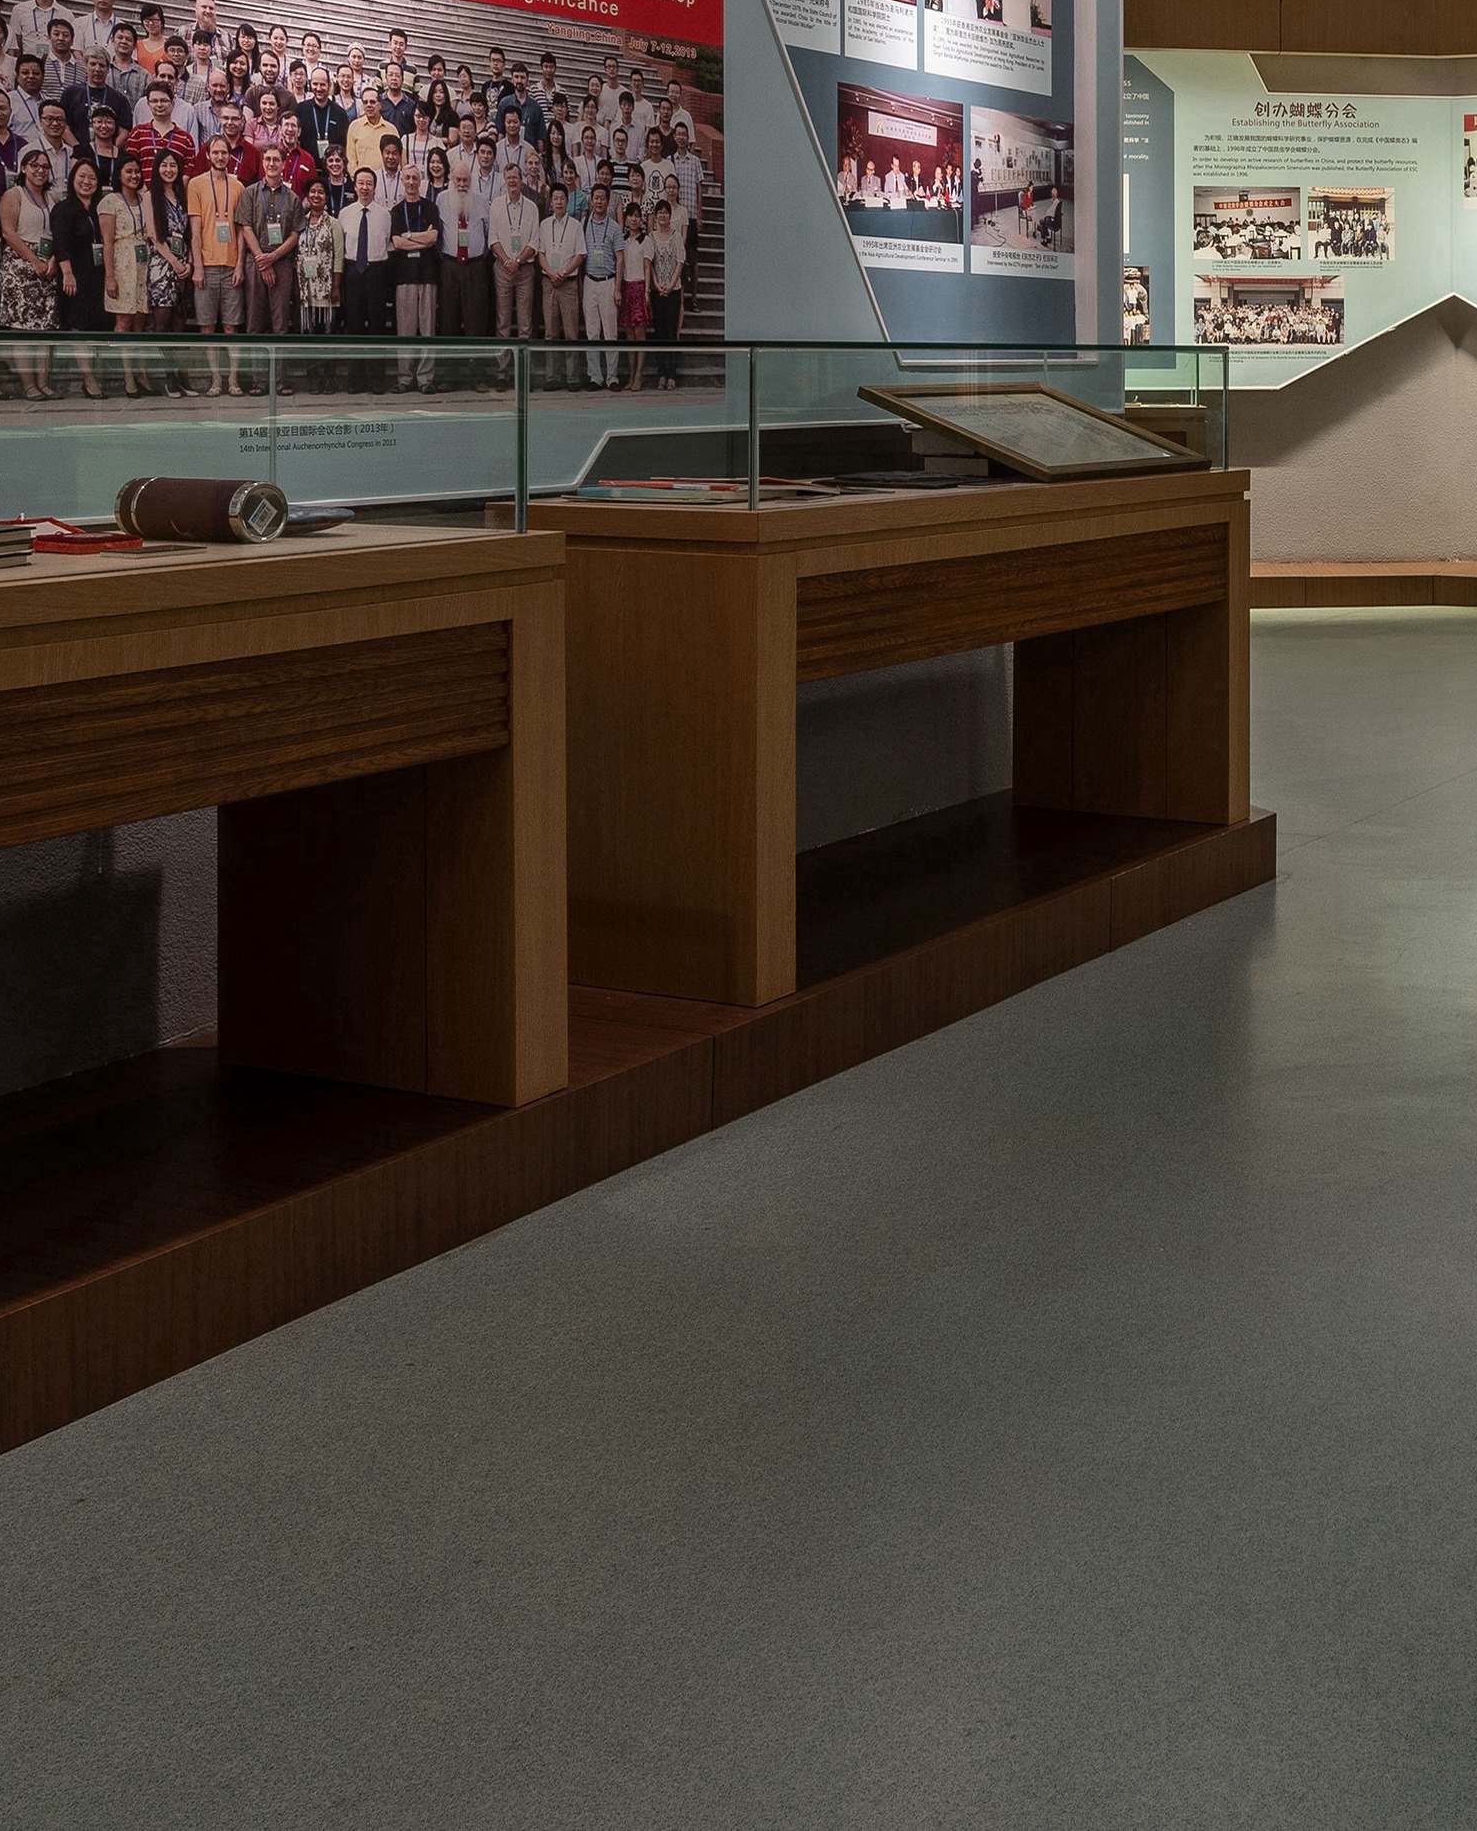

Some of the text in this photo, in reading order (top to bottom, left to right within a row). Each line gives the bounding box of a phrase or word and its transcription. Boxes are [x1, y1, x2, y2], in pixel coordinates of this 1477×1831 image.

[1254, 101, 1358, 120] 创办蝴蝶分会
[1232, 118, 1380, 130] Establishing the Butterfly Association
